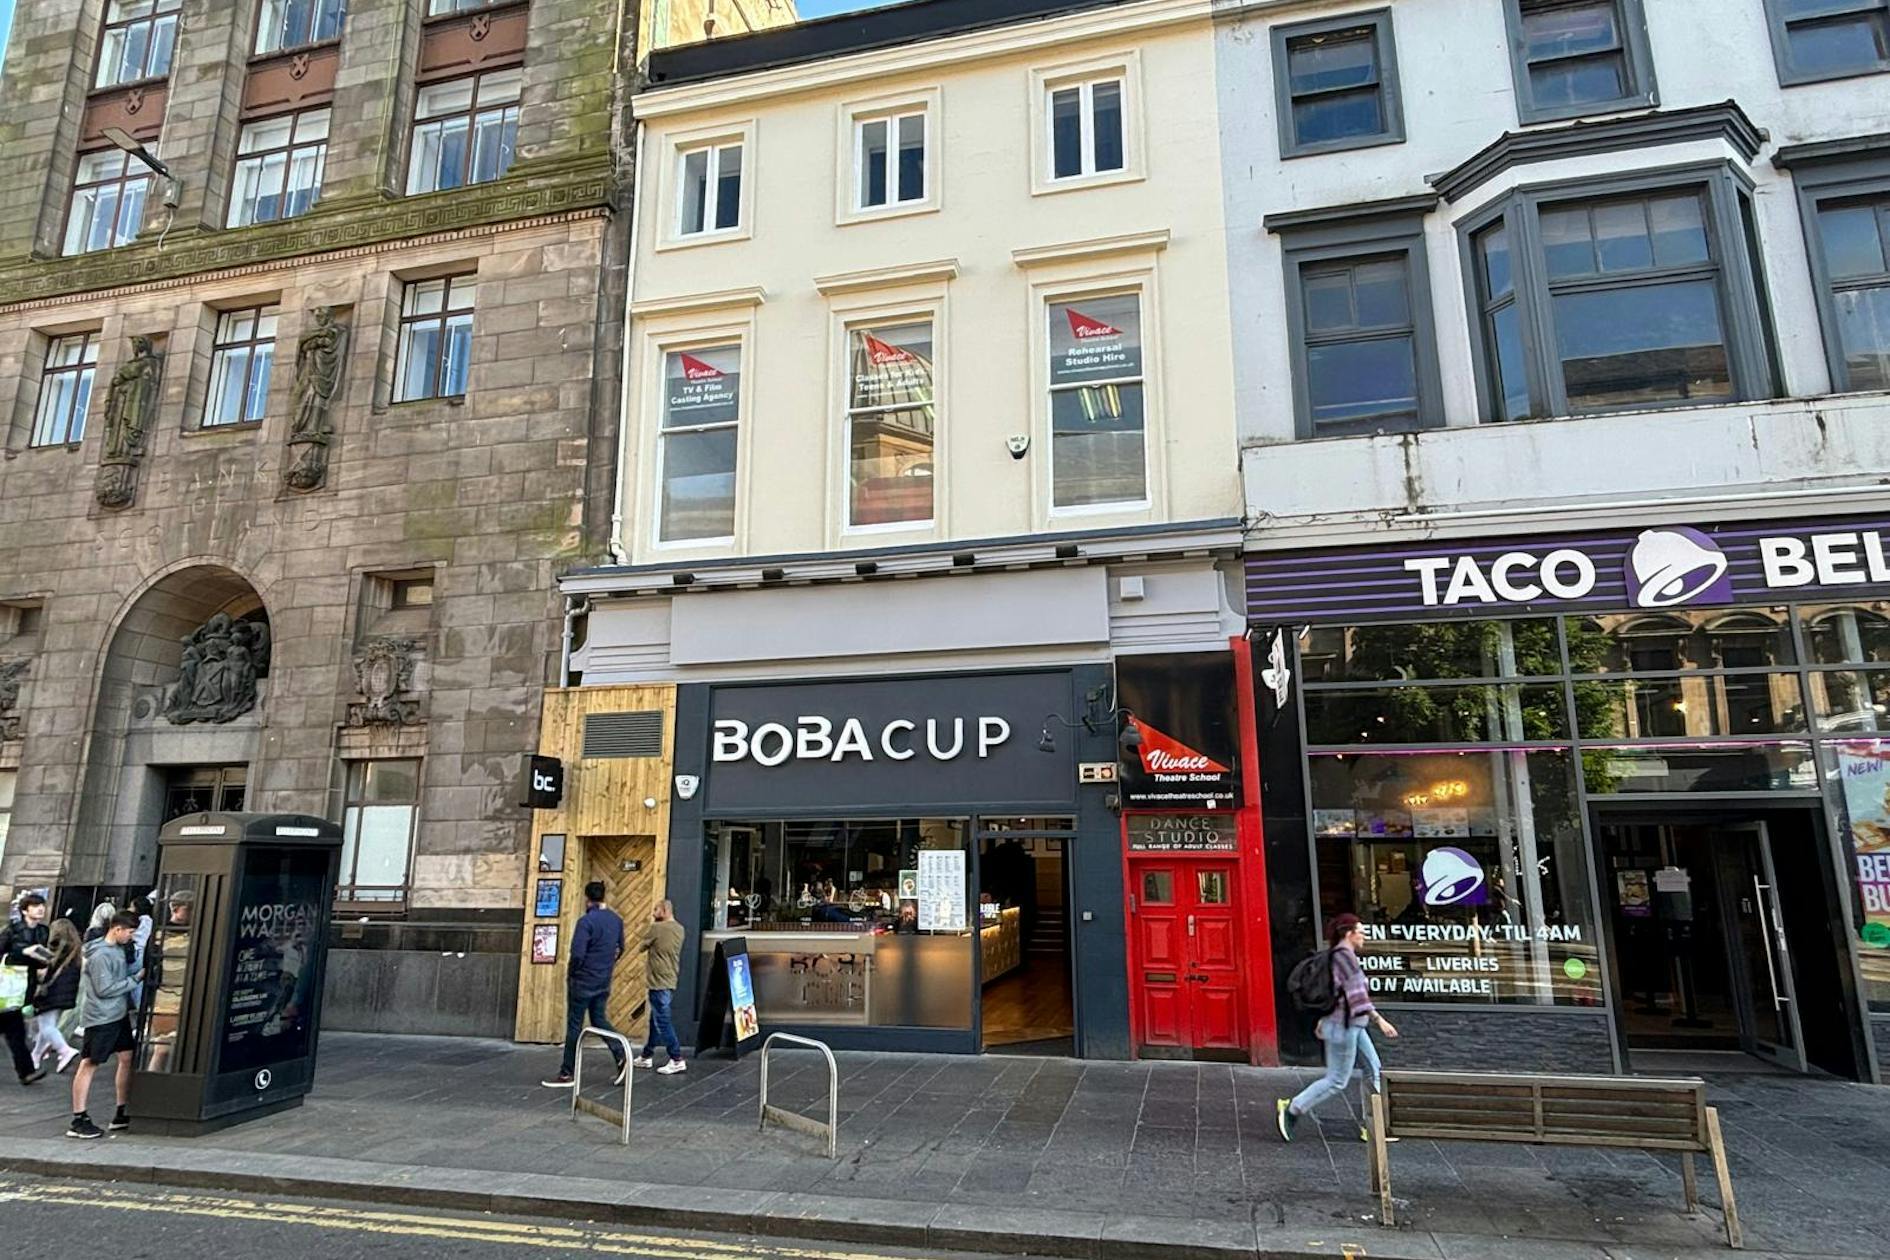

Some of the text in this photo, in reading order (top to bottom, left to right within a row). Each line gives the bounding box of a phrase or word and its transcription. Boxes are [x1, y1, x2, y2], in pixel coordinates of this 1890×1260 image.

[1076, 325, 1112, 337] Vivace
[1068, 343, 1122, 356] Rehearsal
[1065, 353, 1126, 366] Studio Hire
[688, 367, 717, 379] Vivace
[683, 383, 723, 395] TV & Film
[671, 392, 734, 404] Casting Agency
[1404, 549, 1596, 605] TACO
[1146, 749, 1209, 770] Vivace
[1847, 759, 1883, 777] NEW!
[1154, 772, 1221, 782] Theatre School
[1129, 791, 1235, 801] www.vivacetheatreschool.co.uk
[1150, 817, 1211, 830] DANCE
[1144, 830, 1219, 844] STUDIO
[1857, 854, 1890, 883] BE
[241, 903, 319, 921] MORGAN
[240, 919, 317, 939] WALLEN
[1362, 924, 1386, 940] EN
[1390, 924, 1490, 941] EVERYDAY
[1536, 924, 1582, 941] 4AM
[1358, 955, 1403, 971] HOME
[1403, 977, 1491, 993] AVAILABLE
